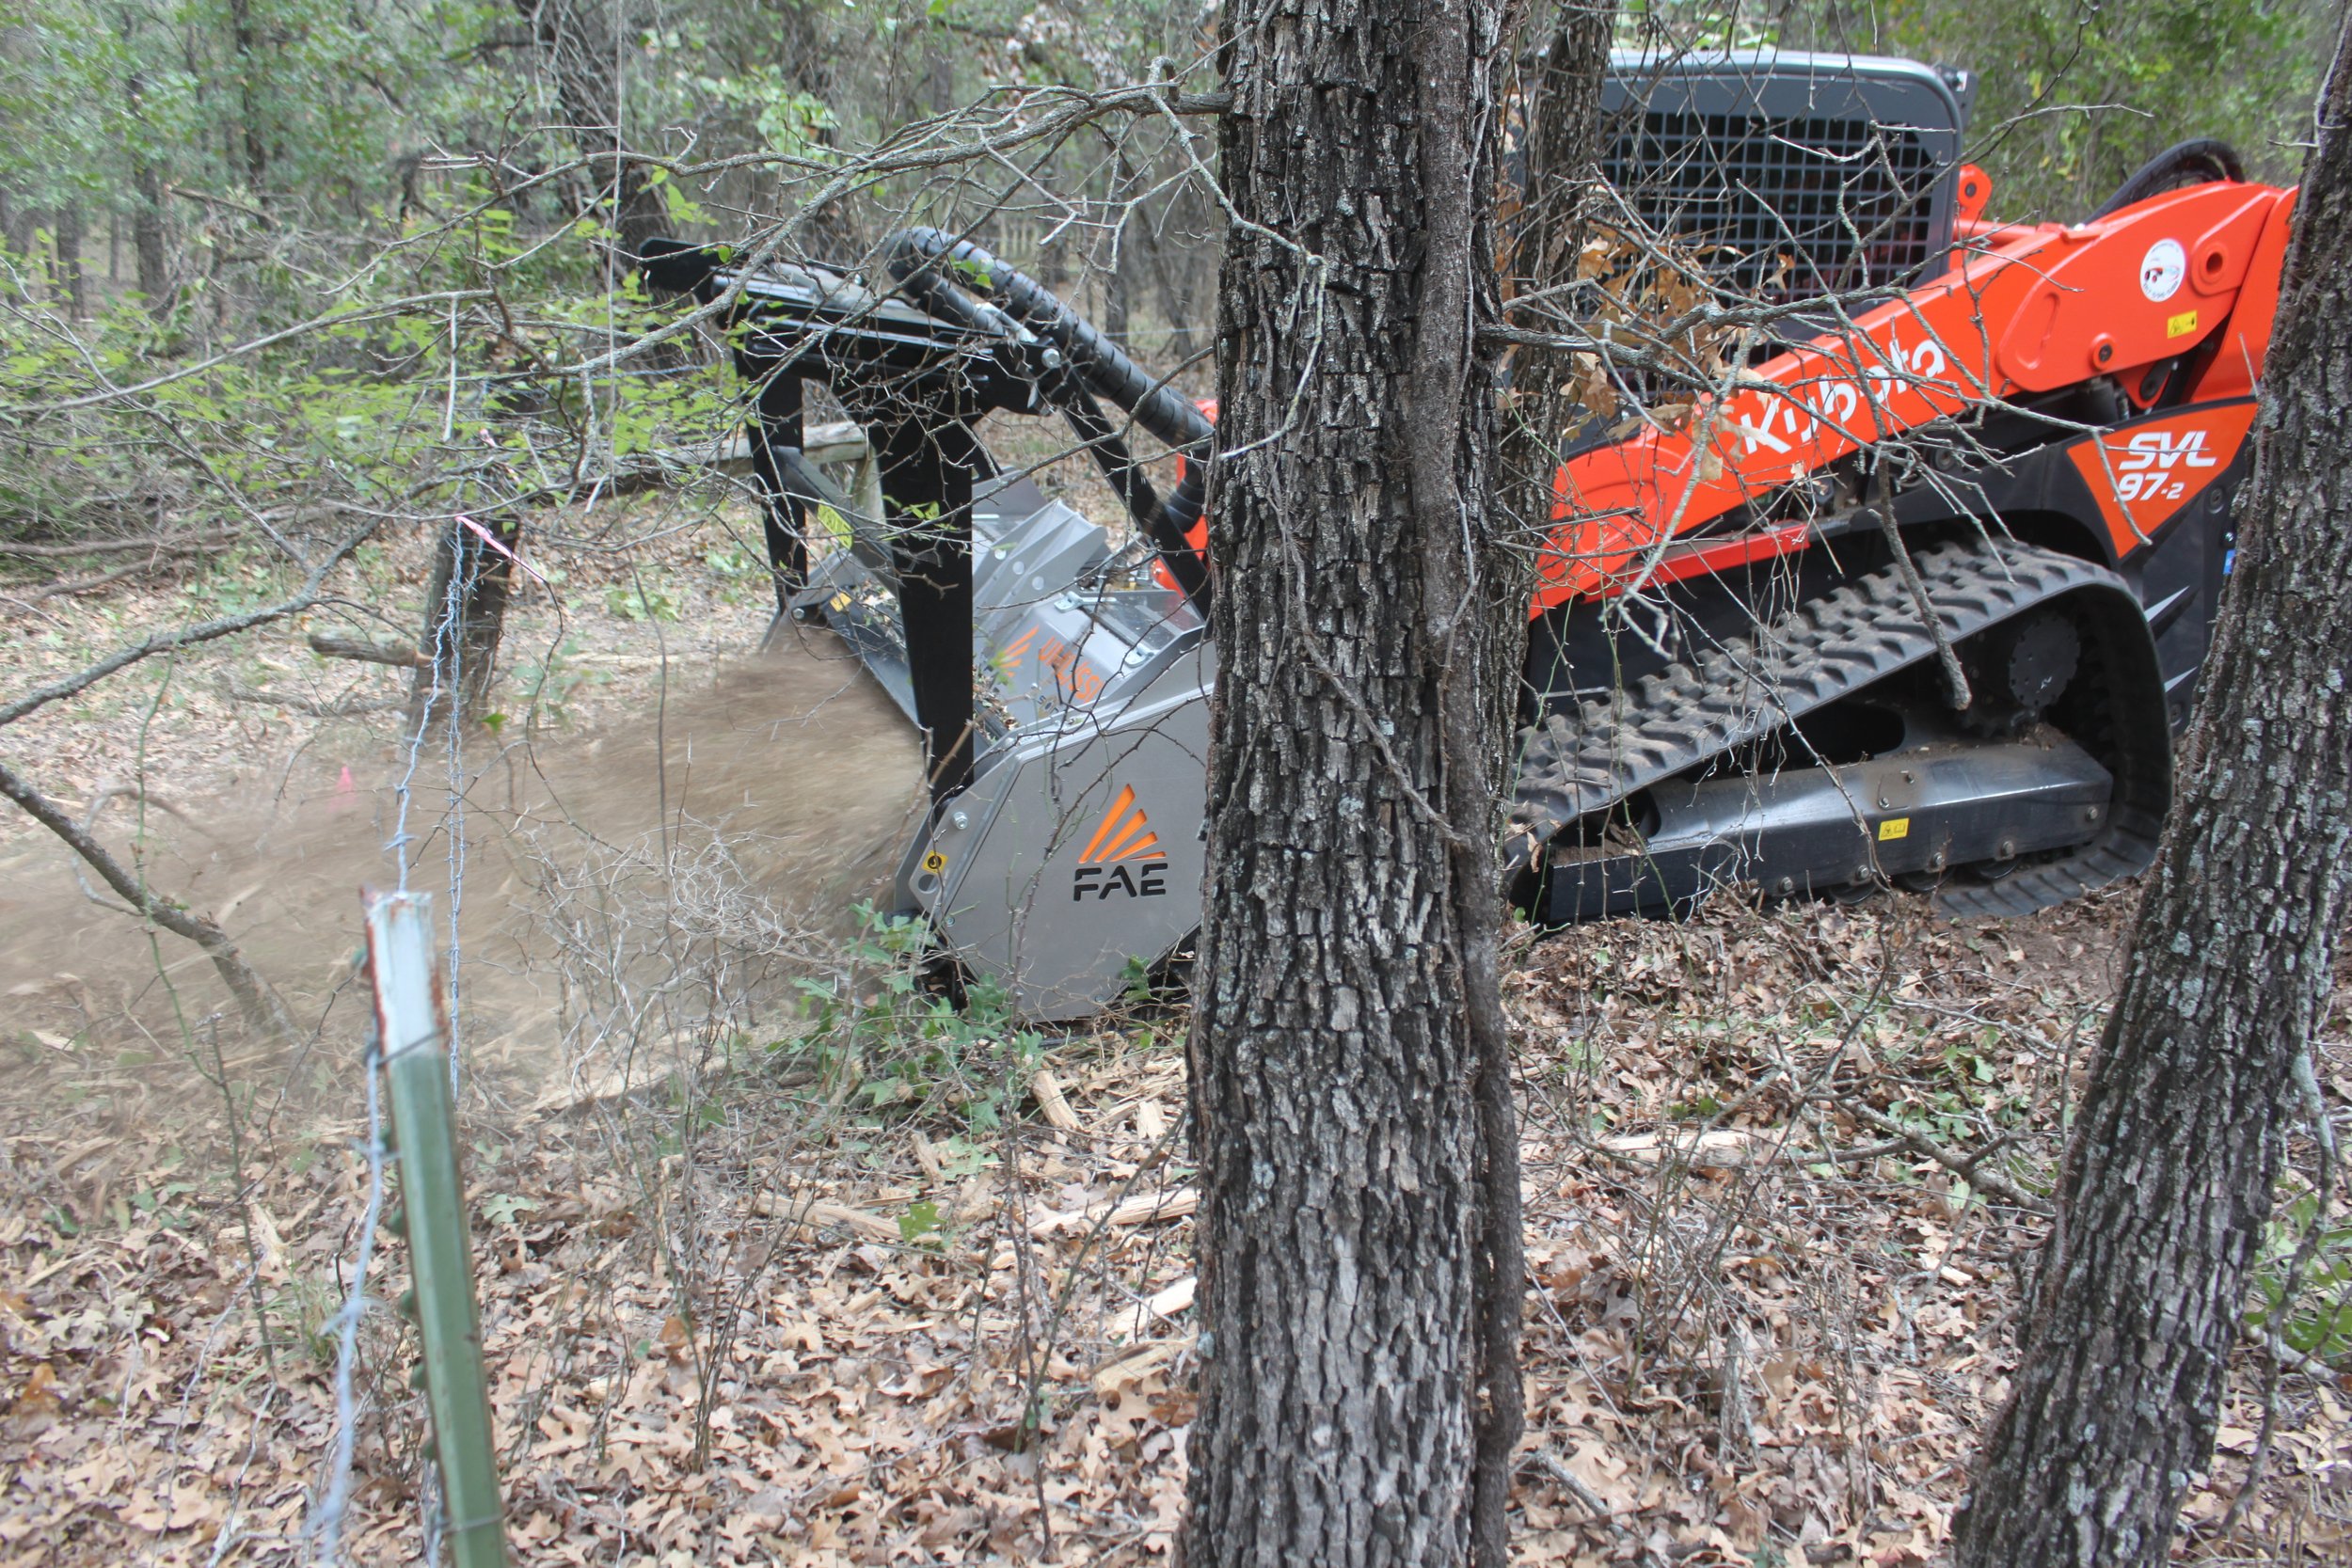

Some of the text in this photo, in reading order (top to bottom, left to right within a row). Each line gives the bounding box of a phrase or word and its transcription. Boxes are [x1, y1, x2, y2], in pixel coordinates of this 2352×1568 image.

[1740, 339, 1946, 454] Kubota
[2119, 431, 2217, 470] SVL
[2113, 472, 2185, 502] 97-2
[1073, 863, 1168, 902] FAE
